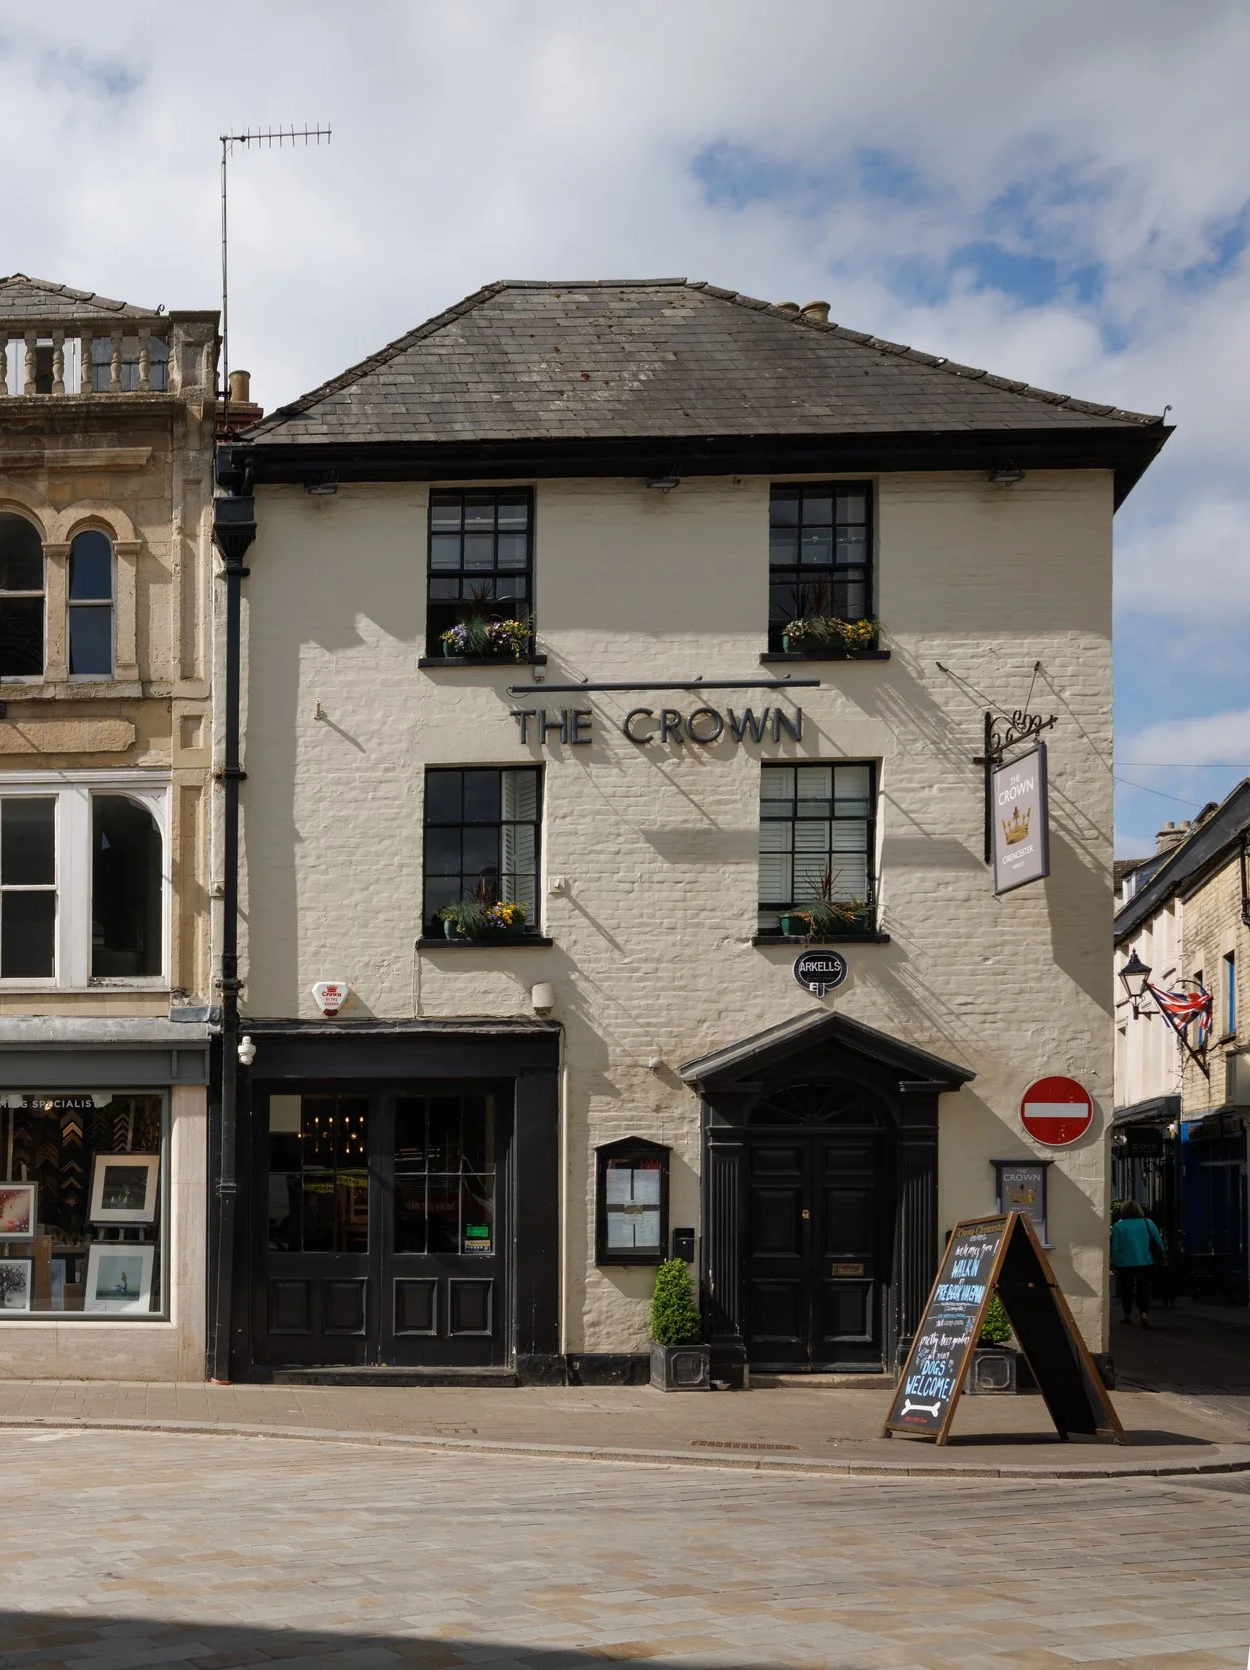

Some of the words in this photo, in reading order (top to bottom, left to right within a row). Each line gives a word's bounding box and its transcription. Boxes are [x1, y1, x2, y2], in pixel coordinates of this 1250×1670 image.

[510, 709, 592, 744] THE
[623, 707, 802, 744] CROWN
[1010, 773, 1022, 785] THE
[998, 777, 1034, 806] CROWN
[1002, 844, 1034, 865] CIRENCESTER
[799, 961, 841, 972] ARKELLS
[1003, 1174, 1041, 1182] CROWN
[922, 1360, 946, 1376] DOGS
[905, 1375, 956, 1402] WELCOME!
